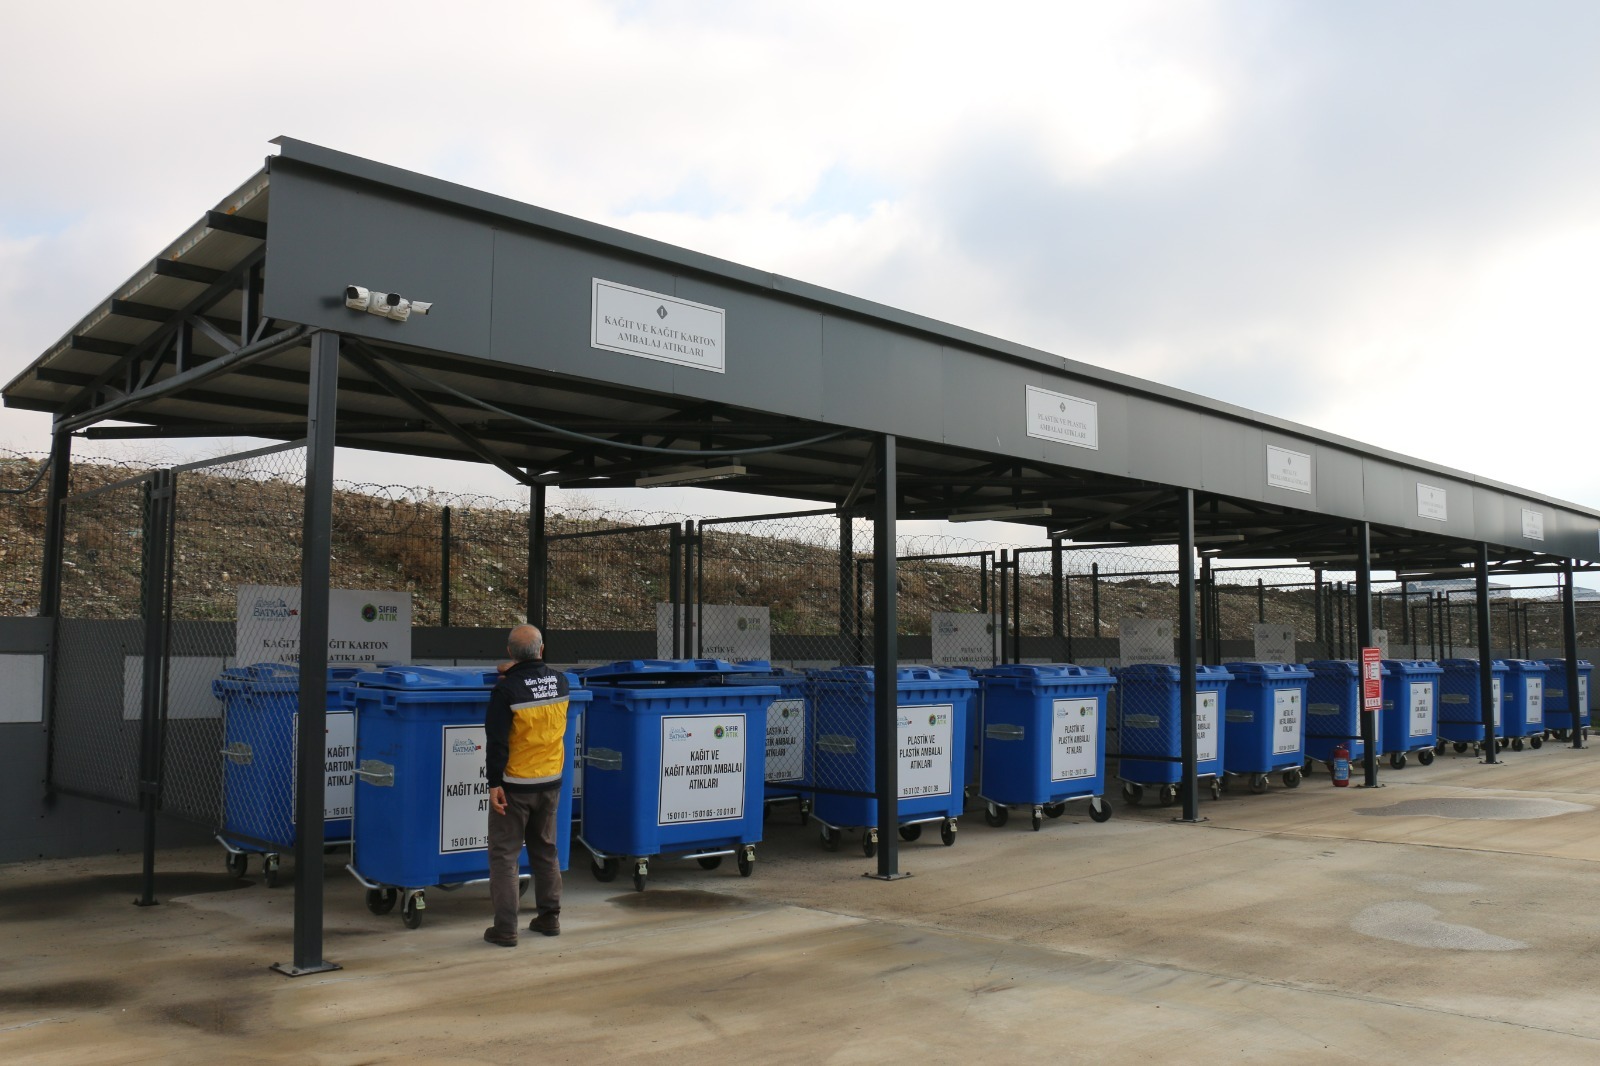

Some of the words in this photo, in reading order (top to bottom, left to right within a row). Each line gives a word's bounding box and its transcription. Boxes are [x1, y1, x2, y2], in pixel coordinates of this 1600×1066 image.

[605, 316, 634, 329] KAĞIT
[637, 322, 648, 332] VE
[651, 326, 678, 340] KAĞIT
[681, 332, 716, 347] KARTON
[618, 332, 661, 348] AMBALAJ
[664, 342, 704, 357] ATIKLARI
[263, 638, 297, 648] KAĞIT
[349, 641, 388, 650] KARTON
[328, 745, 350, 758] KAĞIT
[691, 749, 710, 761] KAĞIT
[711, 750, 719, 760] VE
[665, 764, 684, 777] KAĞIT
[686, 764, 712, 776] KARTON
[714, 763, 742, 774] AMBALAJ
[327, 776, 353, 786] ATIKLA
[689, 778, 718, 789] ATIKLARI
[447, 782, 471, 796] KAĞIT
